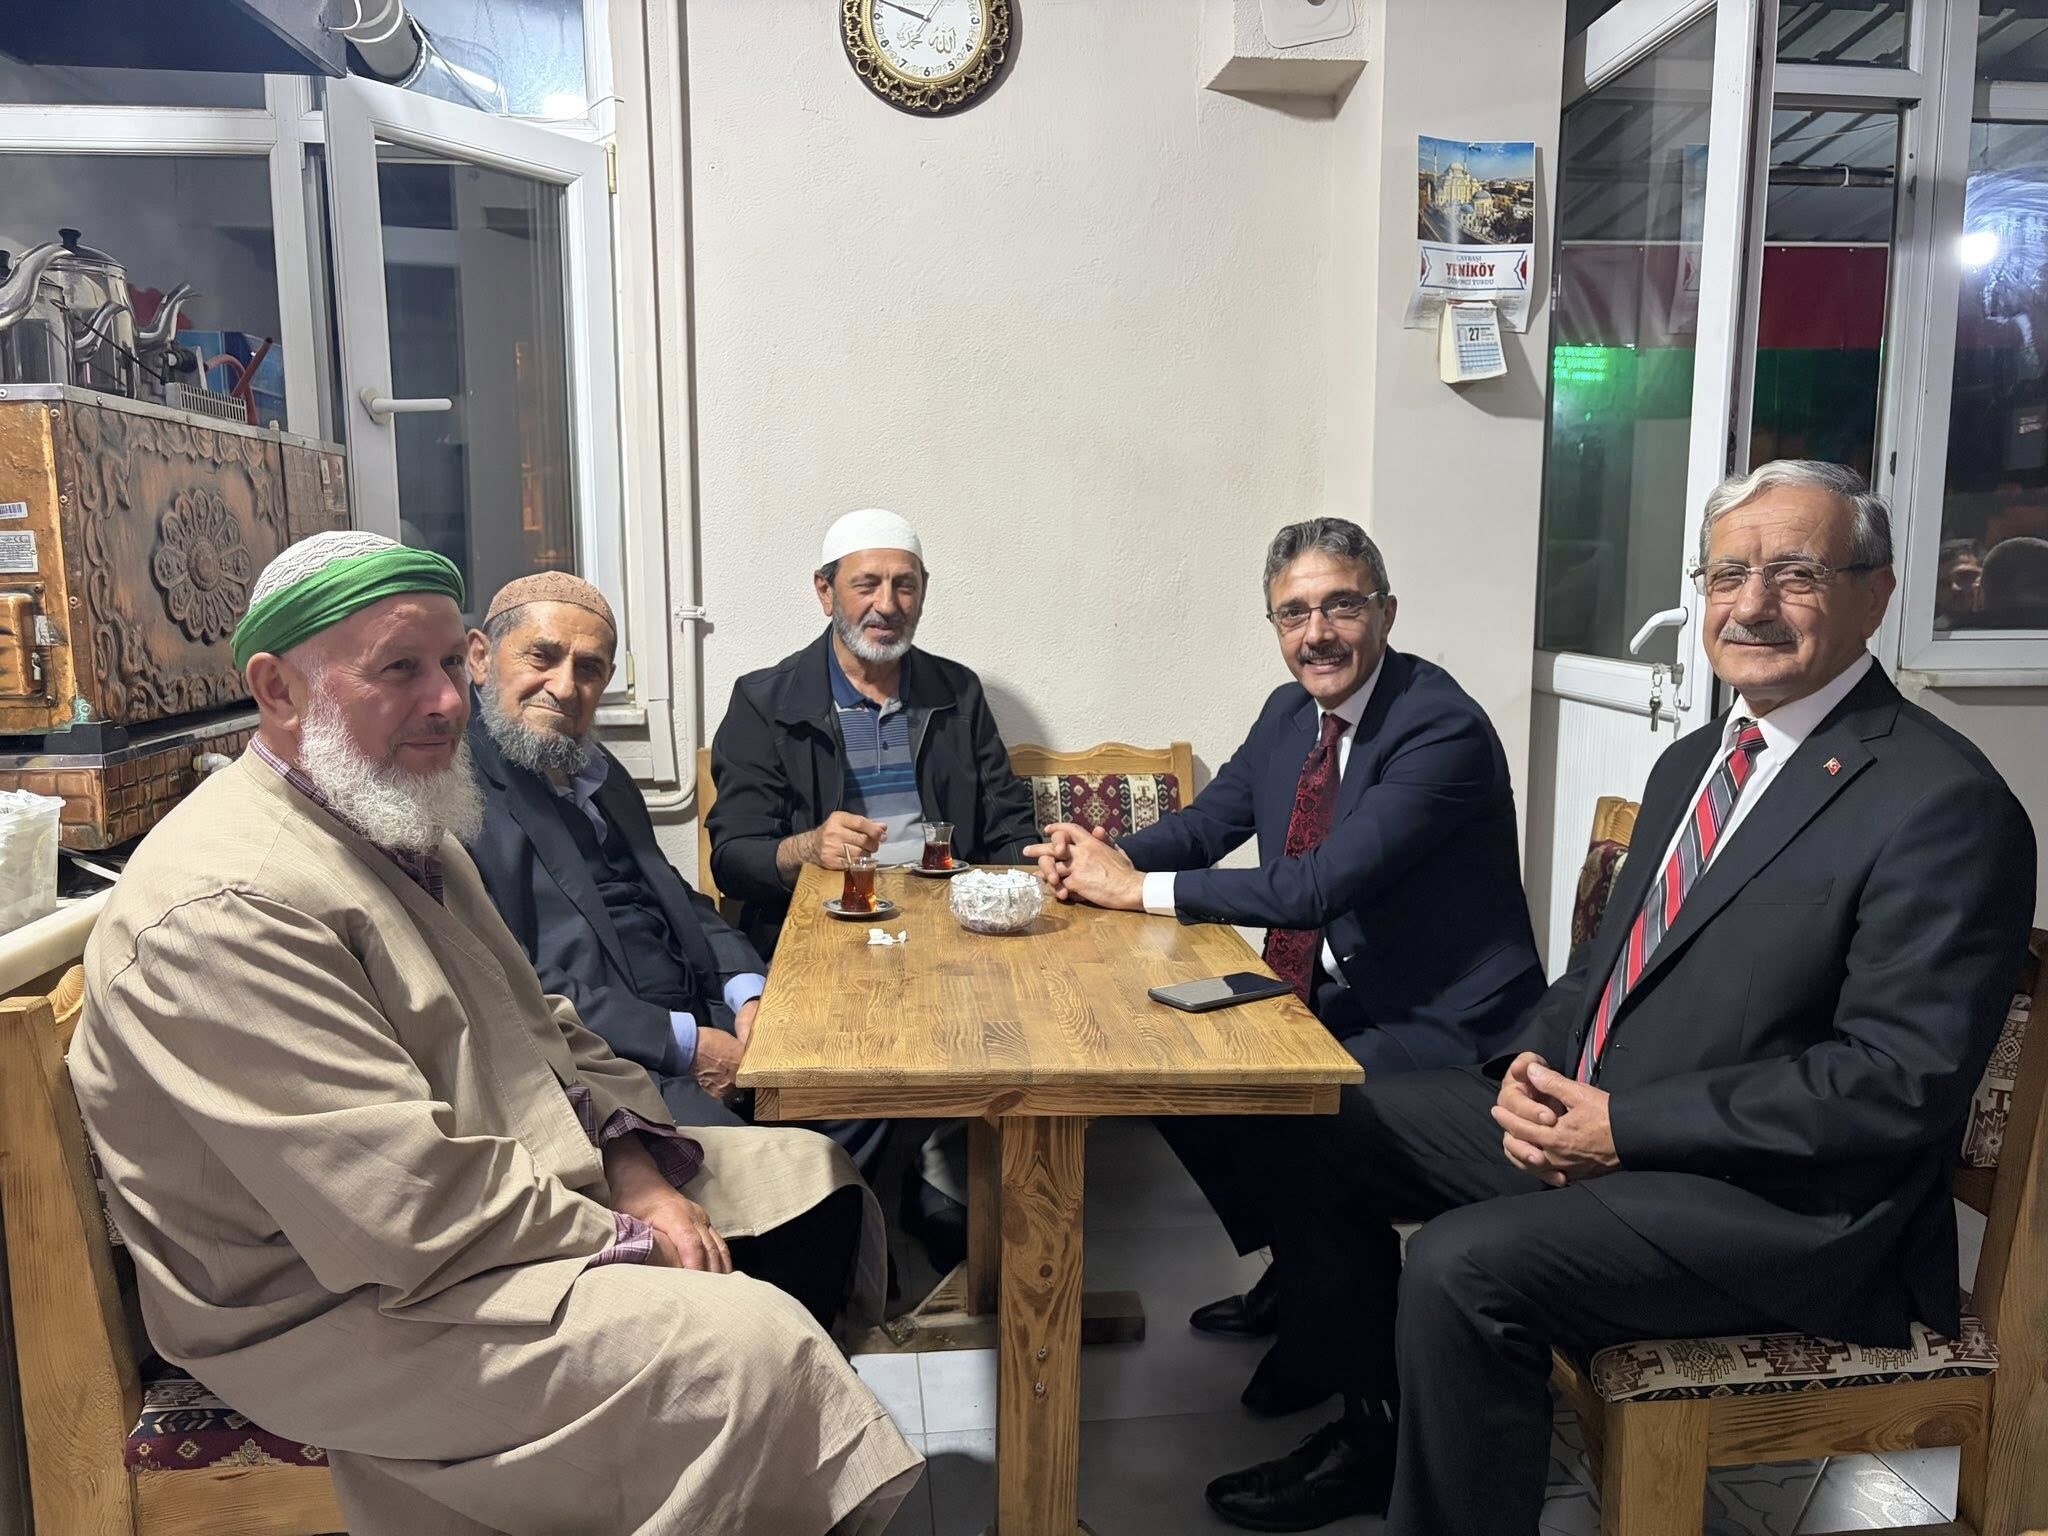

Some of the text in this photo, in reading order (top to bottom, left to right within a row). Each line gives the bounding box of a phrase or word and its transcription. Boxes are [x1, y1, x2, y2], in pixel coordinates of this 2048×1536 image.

[873, 12, 883, 20] 9
[971, 16, 981, 25] 3
[880, 39, 890, 48] 8
[965, 44, 973, 52] 4
[899, 58, 908, 68] 7
[948, 60, 955, 71] 5
[923, 67, 931, 77] 6
[1446, 262, 1495, 278] YENİKÖY
[1468, 327, 1480, 341] 27
